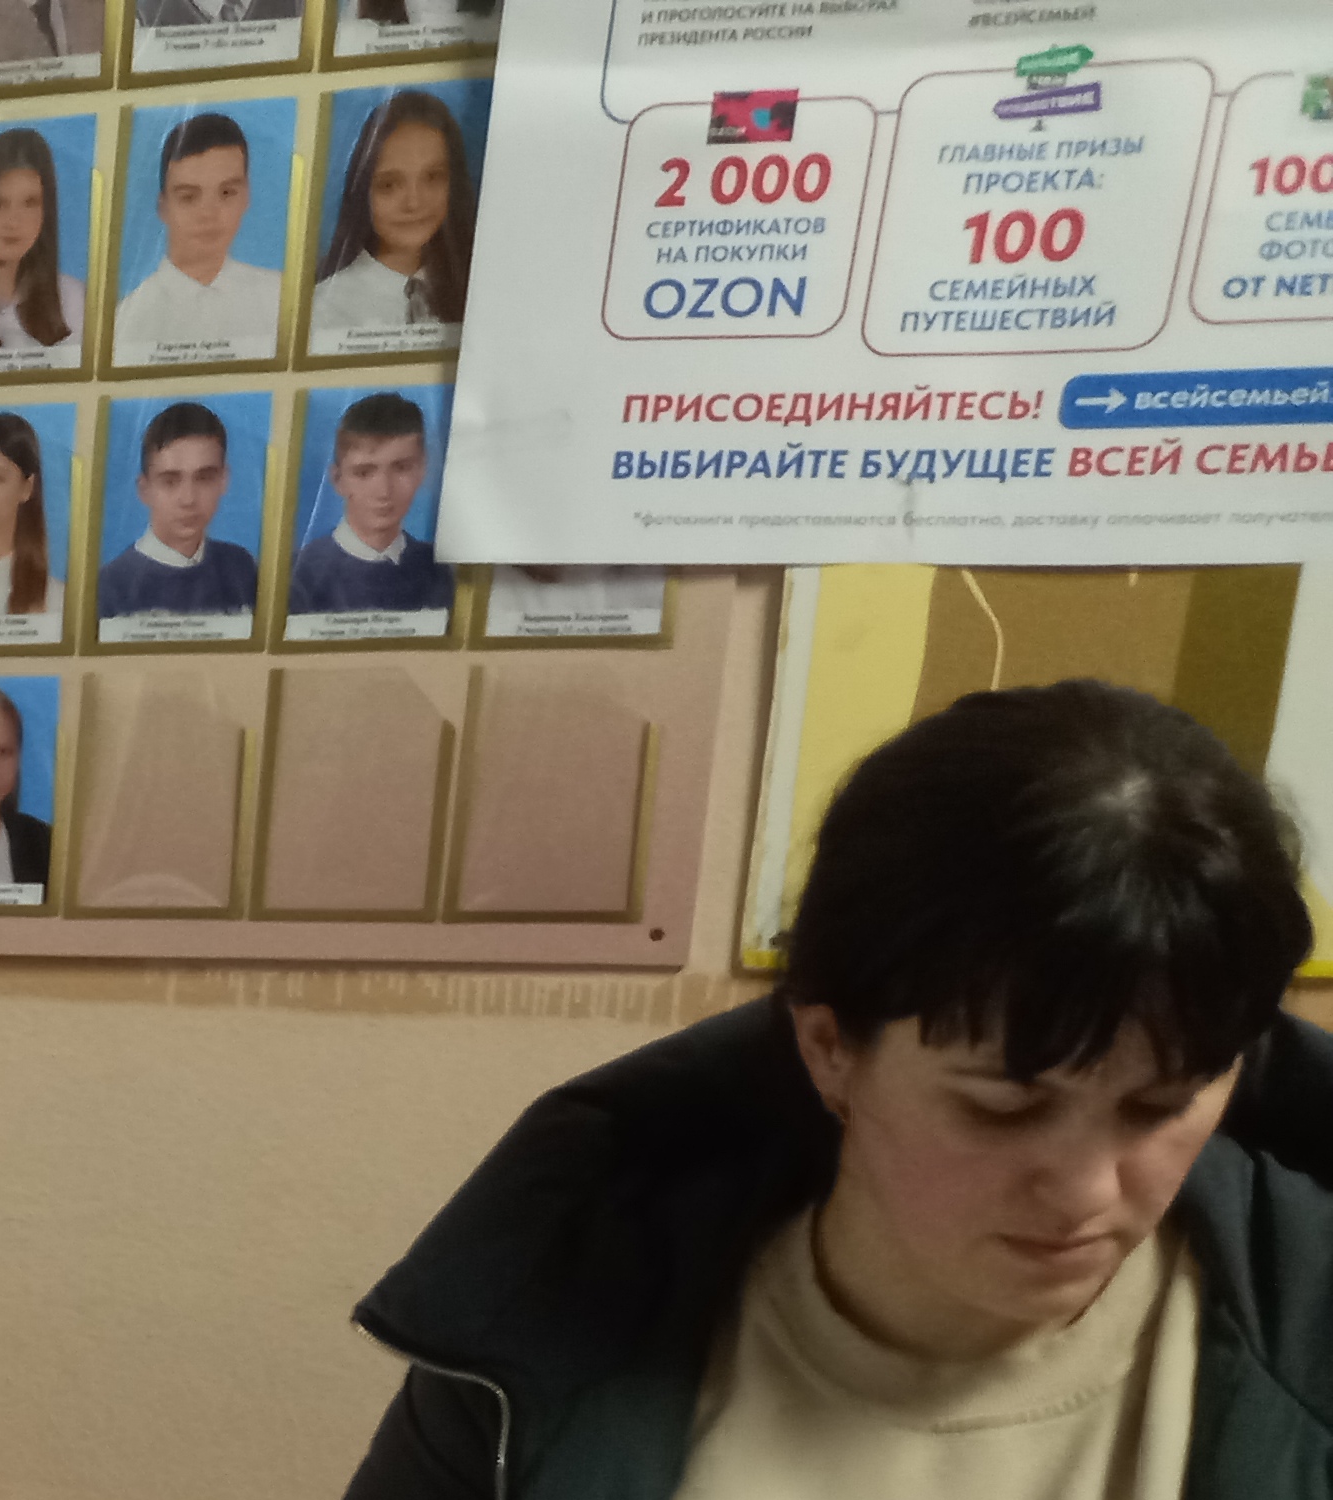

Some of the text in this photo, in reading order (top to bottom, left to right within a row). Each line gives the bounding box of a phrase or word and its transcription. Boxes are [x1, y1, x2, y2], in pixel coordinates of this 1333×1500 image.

[937, 135, 1145, 165] ГЛАВНЫЕ ПРИЗЫ
[654, 151, 832, 208] 2 000
[962, 167, 1105, 194] ПРОЕКТА:
[1249, 153, 1333, 196] 100
[646, 216, 827, 239] СЕРТИФИКАТОВ
[963, 206, 1086, 265] 100
[656, 243, 808, 264] НА ПОКУПКИ
[643, 276, 807, 319] OZON
[929, 273, 1096, 301] СЕМЕЙНЫХ
[1222, 275, 1267, 299] ОТ
[900, 301, 1118, 332] ПУТЕШЕСТВИЙ
[622, 384, 1044, 427] ПРИСОЕДИНЯЙТЕСЬ!
[611, 442, 849, 480] ВЫБИРАЙТЕ
[859, 448, 1056, 484] БУДУЩЕЕ
[1068, 437, 1184, 477] ВСЕЙ
